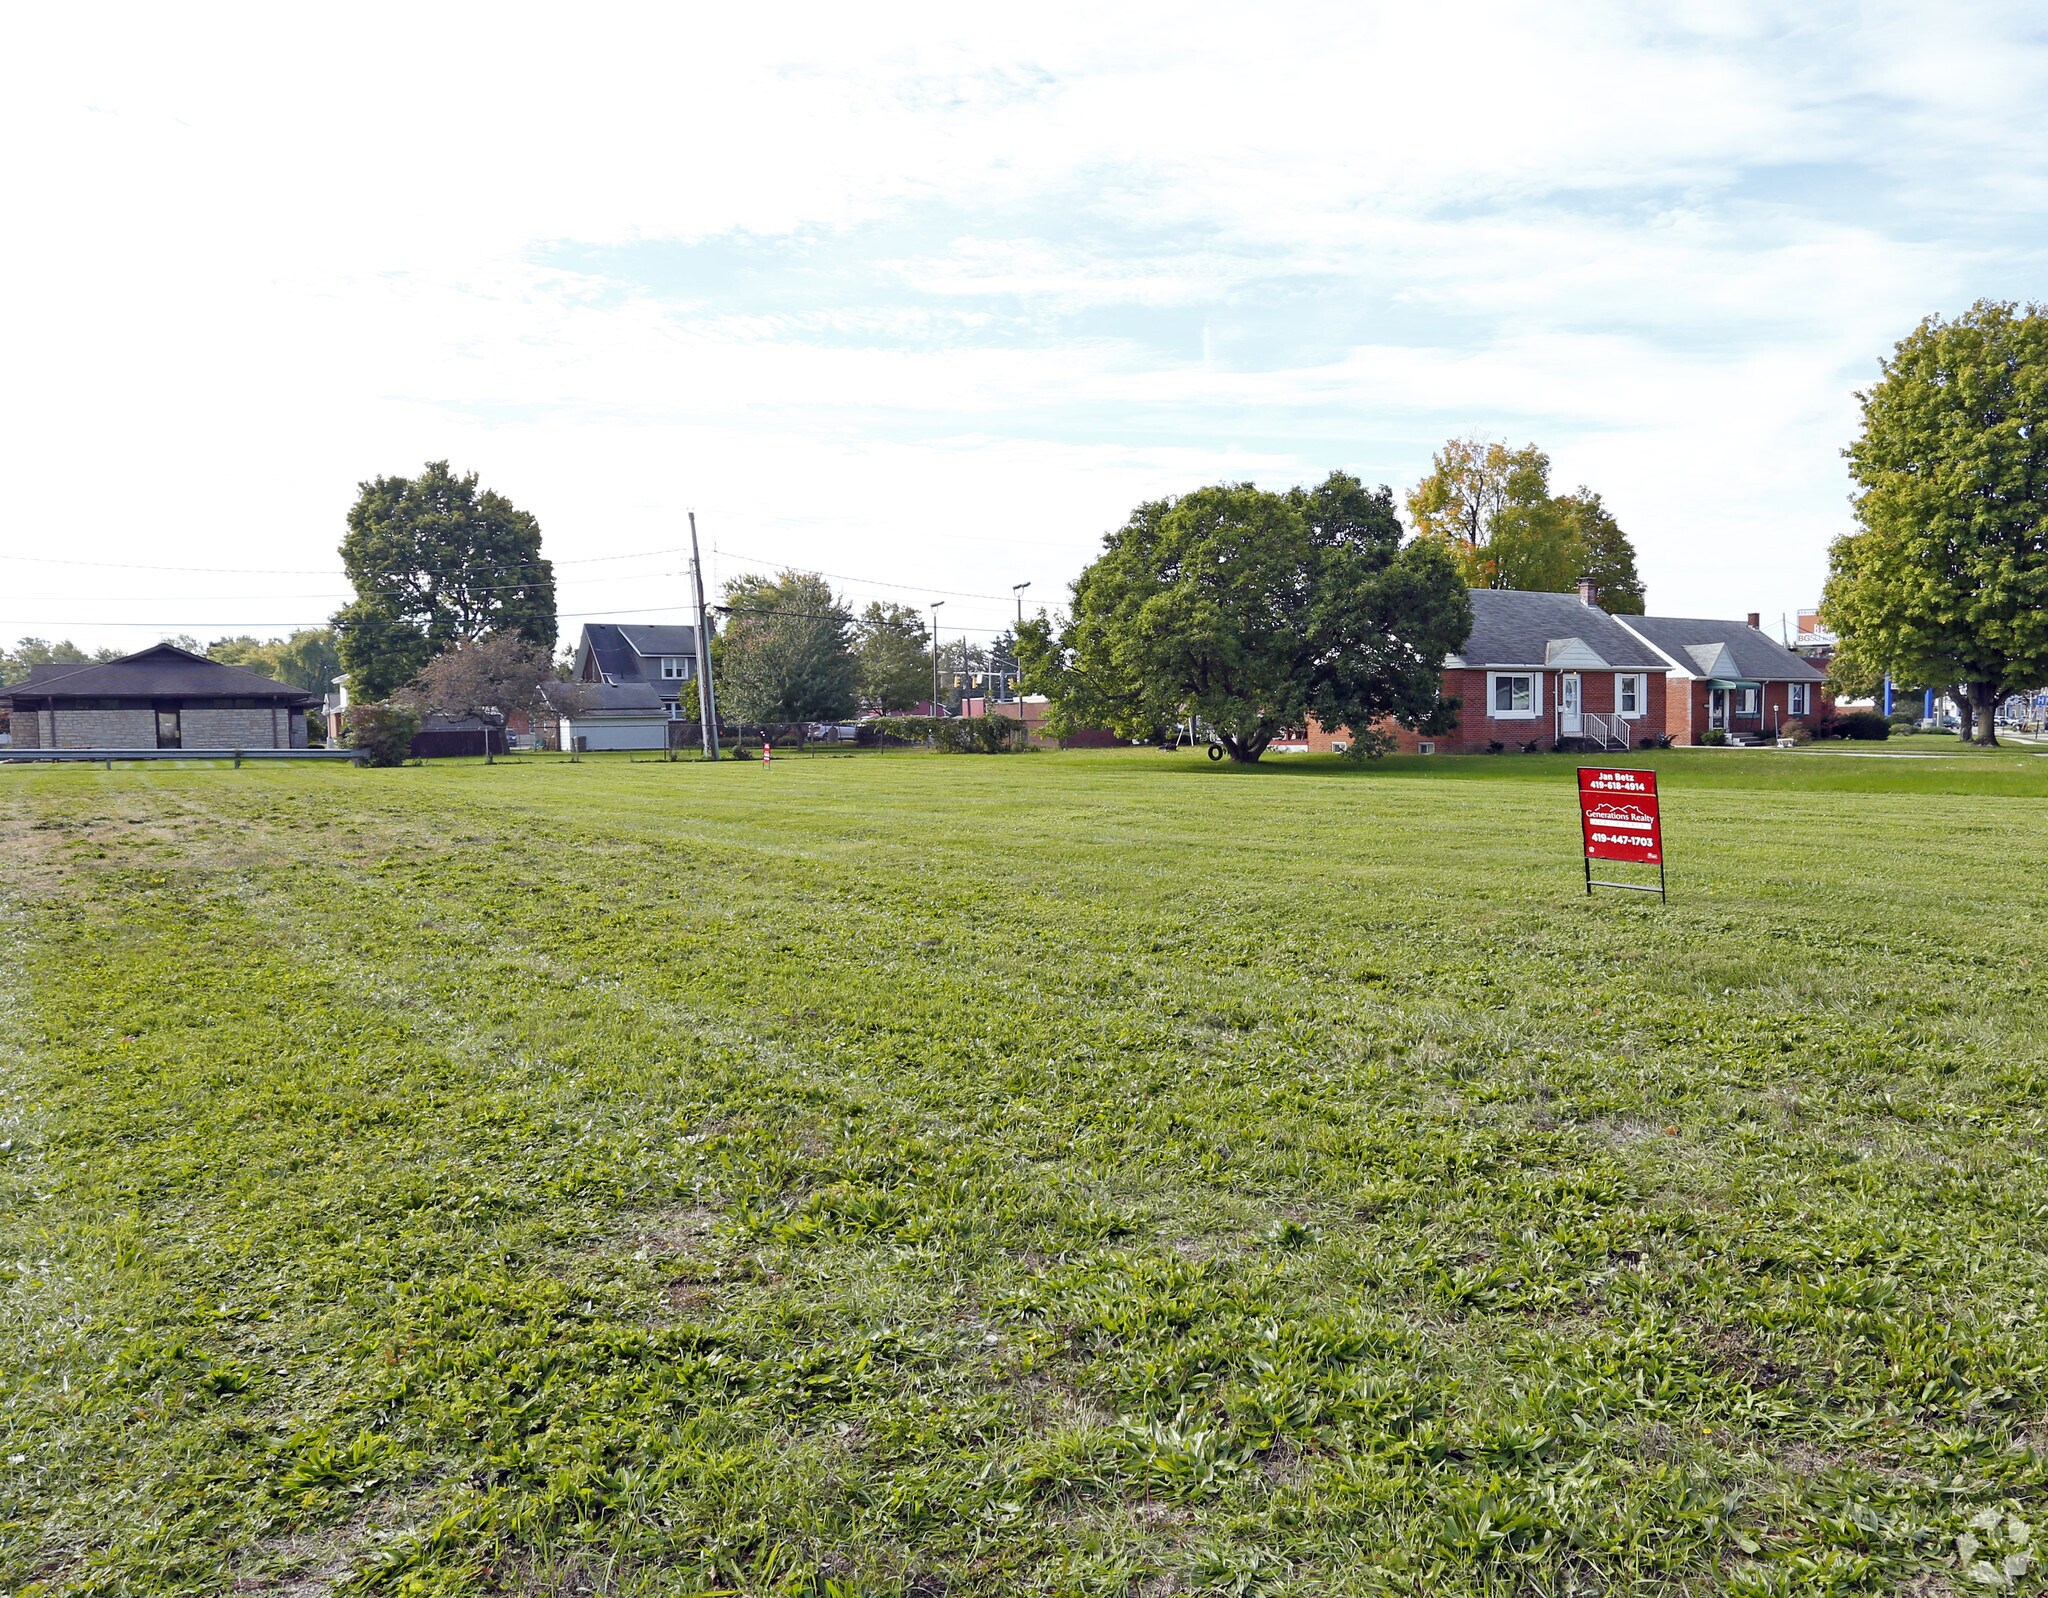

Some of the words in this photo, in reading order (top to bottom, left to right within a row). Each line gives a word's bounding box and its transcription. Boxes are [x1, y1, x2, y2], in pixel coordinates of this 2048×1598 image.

[1599, 772, 1613, 781] Jan
[1615, 773, 1634, 782] Betz
[1590, 781, 1645, 791] 419-618-4914
[1586, 809, 1629, 821] Generations
[1631, 813, 1654, 824] Realty
[1591, 832, 1653, 847] 419-447-1703
